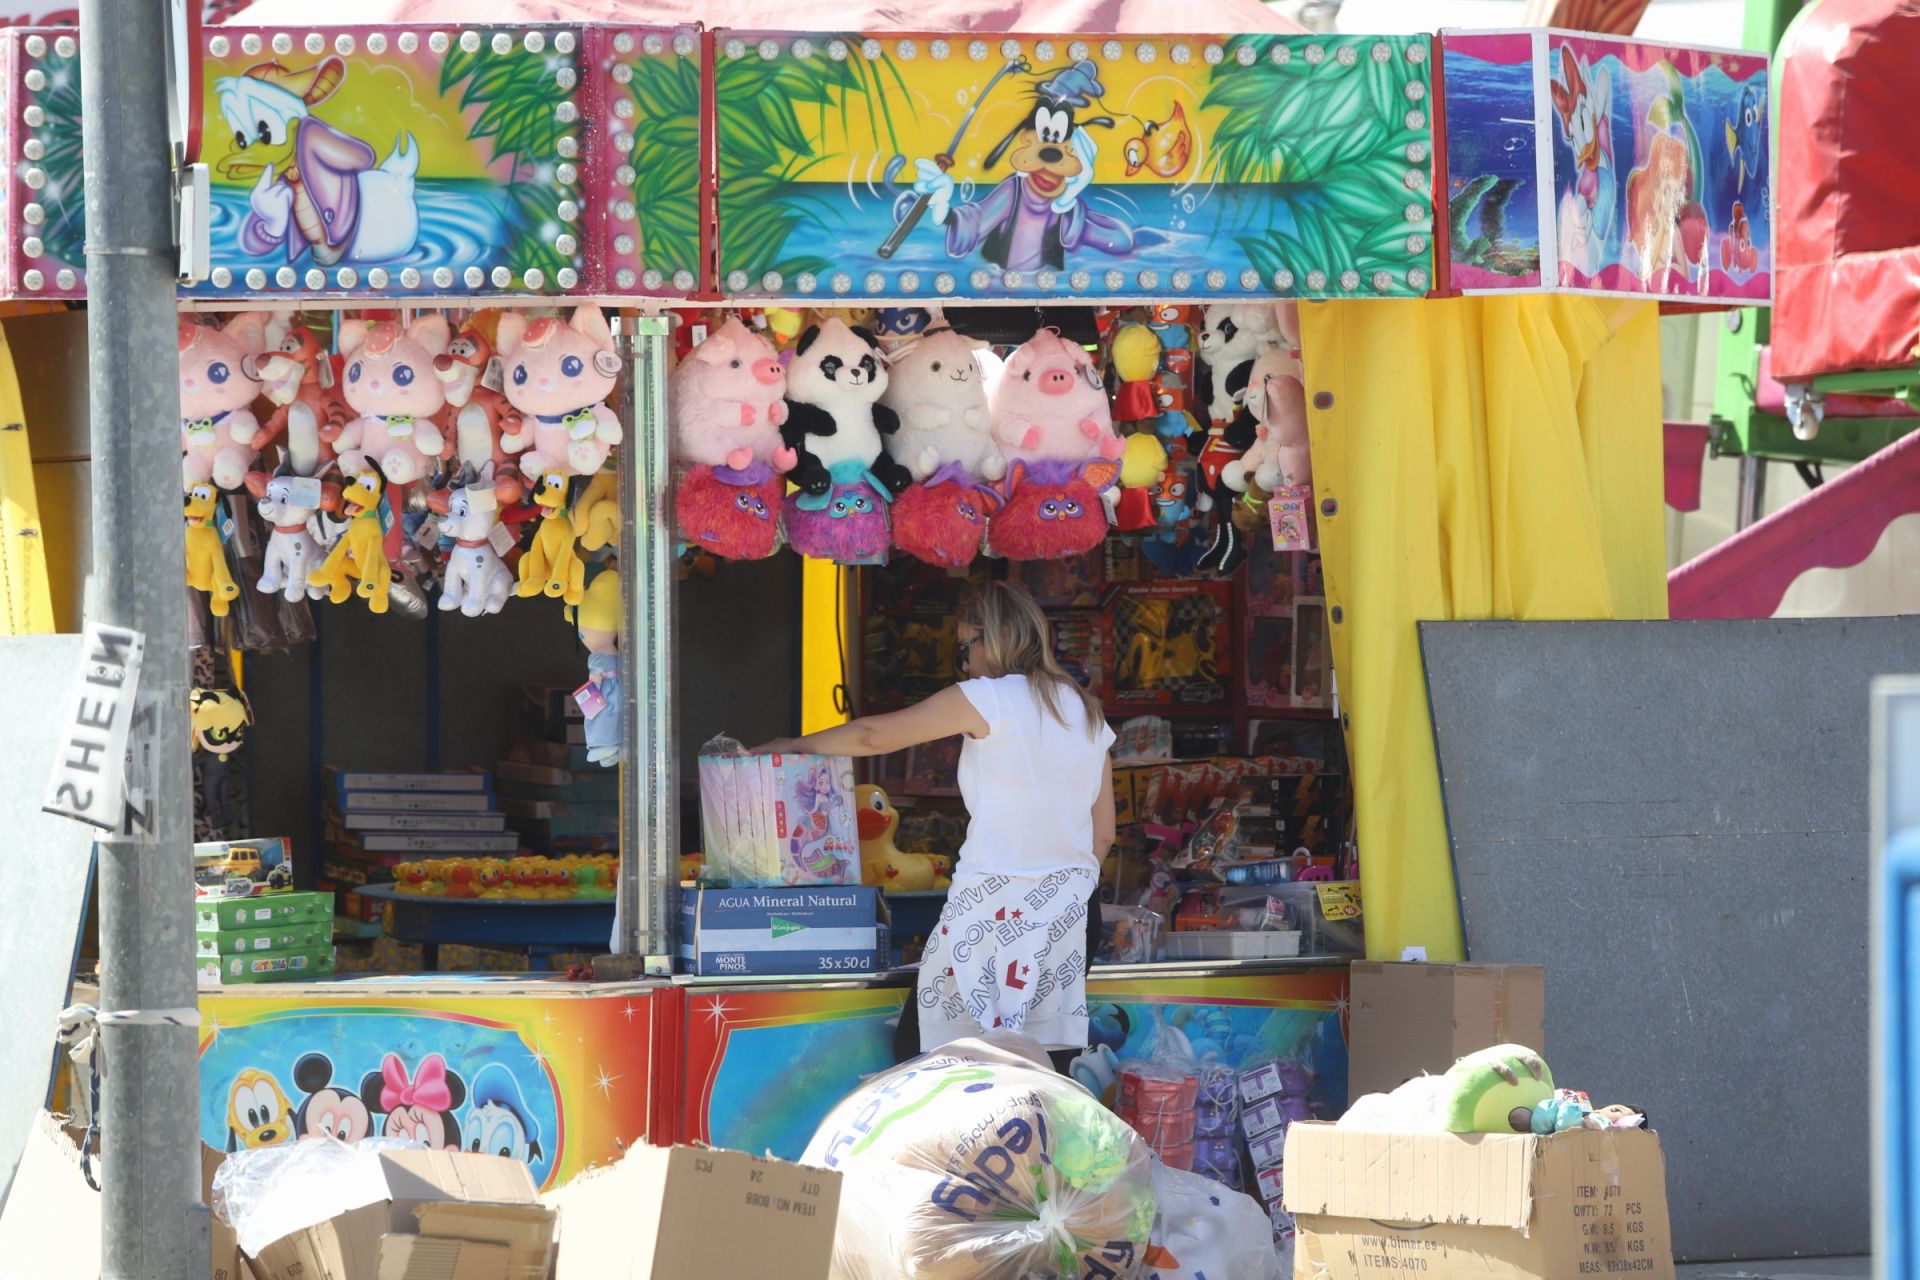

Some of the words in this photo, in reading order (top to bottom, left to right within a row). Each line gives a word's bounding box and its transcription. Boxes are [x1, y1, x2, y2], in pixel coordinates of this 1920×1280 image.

[719, 898, 750, 908] AGUA
[753, 895, 804, 908] Mineral
[808, 895, 857, 907] Natural
[715, 956, 745, 964] MONTE
[818, 957, 833, 969] 35
[843, 956, 858, 969] 50
[859, 956, 870, 969] cl
[719, 963, 746, 971] PINOS
[694, 1158, 713, 1173] PCS
[750, 1170, 765, 1183] 24
[1577, 1186, 1599, 1198] ITEM:
[792, 1201, 816, 1216] ITEM
[1573, 1205, 1599, 1217] QWTY:
[1604, 1205, 1613, 1217] 72
[1626, 1203, 1641, 1215] PCS
[1626, 1221, 1644, 1233] KGS
[1361, 1235, 1438, 1251] www.bimar.es
[1627, 1240, 1645, 1252] KGS
[1579, 1261, 1602, 1274] MEAS:
